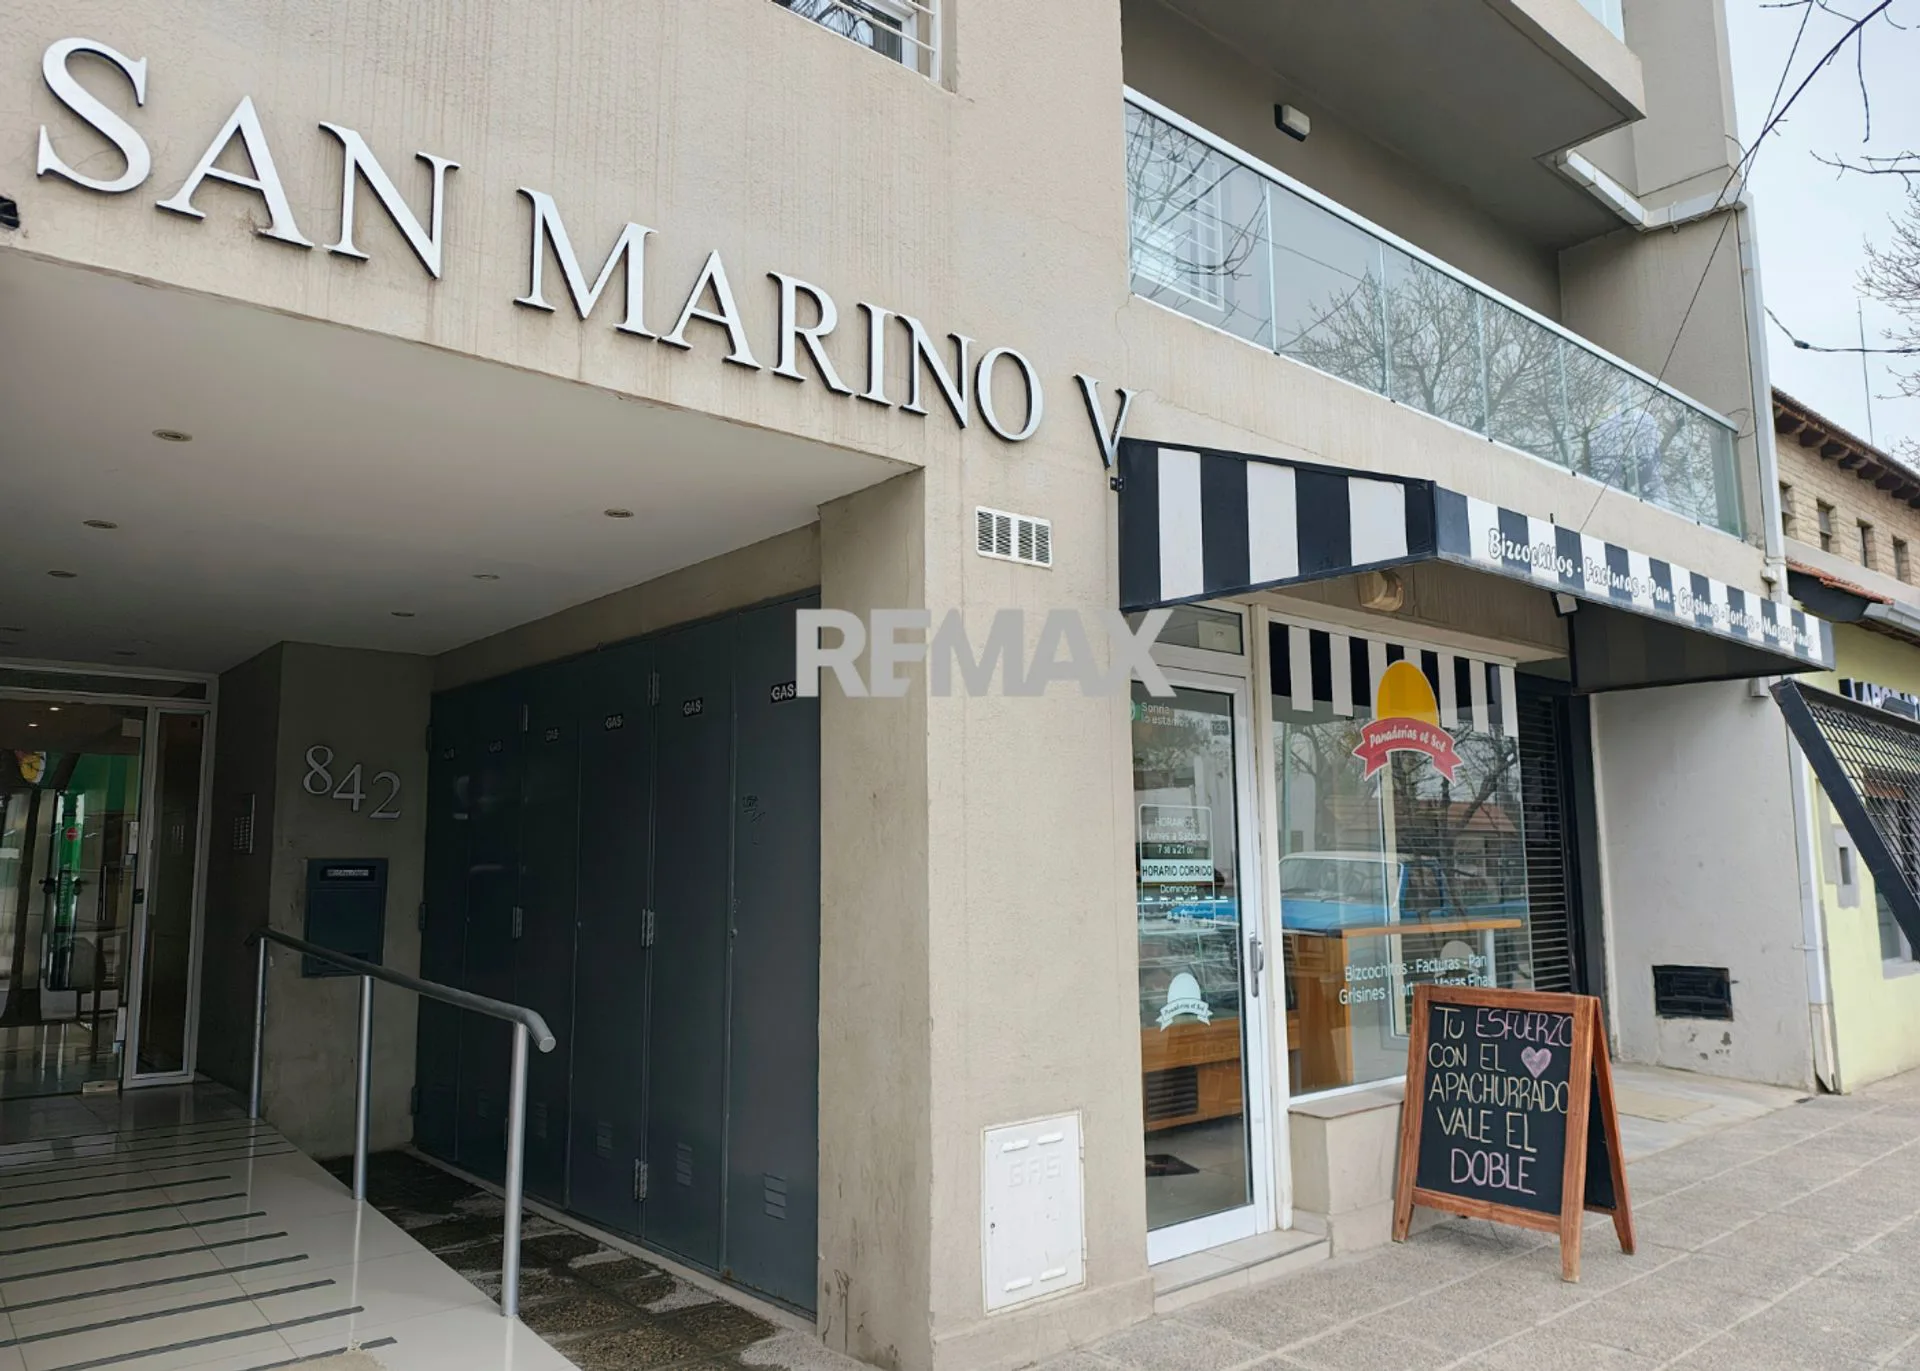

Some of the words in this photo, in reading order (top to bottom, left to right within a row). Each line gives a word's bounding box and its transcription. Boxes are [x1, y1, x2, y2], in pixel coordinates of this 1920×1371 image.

[36, 37, 462, 280] SAN
[512, 187, 1044, 443] MARINO
[1072, 373, 1138, 469] V
[1488, 528, 1574, 578] Bizcochitos
[1584, 556, 1641, 598] Facturas
[1648, 576, 1671, 604] Pan
[683, 699, 702, 715] GAS
[770, 682, 796, 702] GAS
[605, 716, 623, 729] GAS
[1369, 725, 1418, 748] Panaderías
[1431, 733, 1447, 752] Sol
[303, 744, 401, 819] 842
[1142, 864, 1178, 877] HORARIO
[1179, 864, 1213, 877] CORRIDO
[1160, 883, 1198, 895] Domingos
[1344, 961, 1409, 982] Bizcochitos
[1415, 957, 1462, 974] Facturas
[1467, 953, 1488, 969] Pan
[1338, 985, 1386, 1005] Grisines
[1475, 1007, 1574, 1048] ESFUERZO
[1428, 1042, 1468, 1069] CON
[1479, 1043, 1507, 1073] EL
[1428, 1072, 1570, 1114] APACHURRADO
[1436, 1106, 1494, 1144] VALE
[1505, 1111, 1538, 1153] EL
[1451, 1148, 1537, 1195] DOBLE
